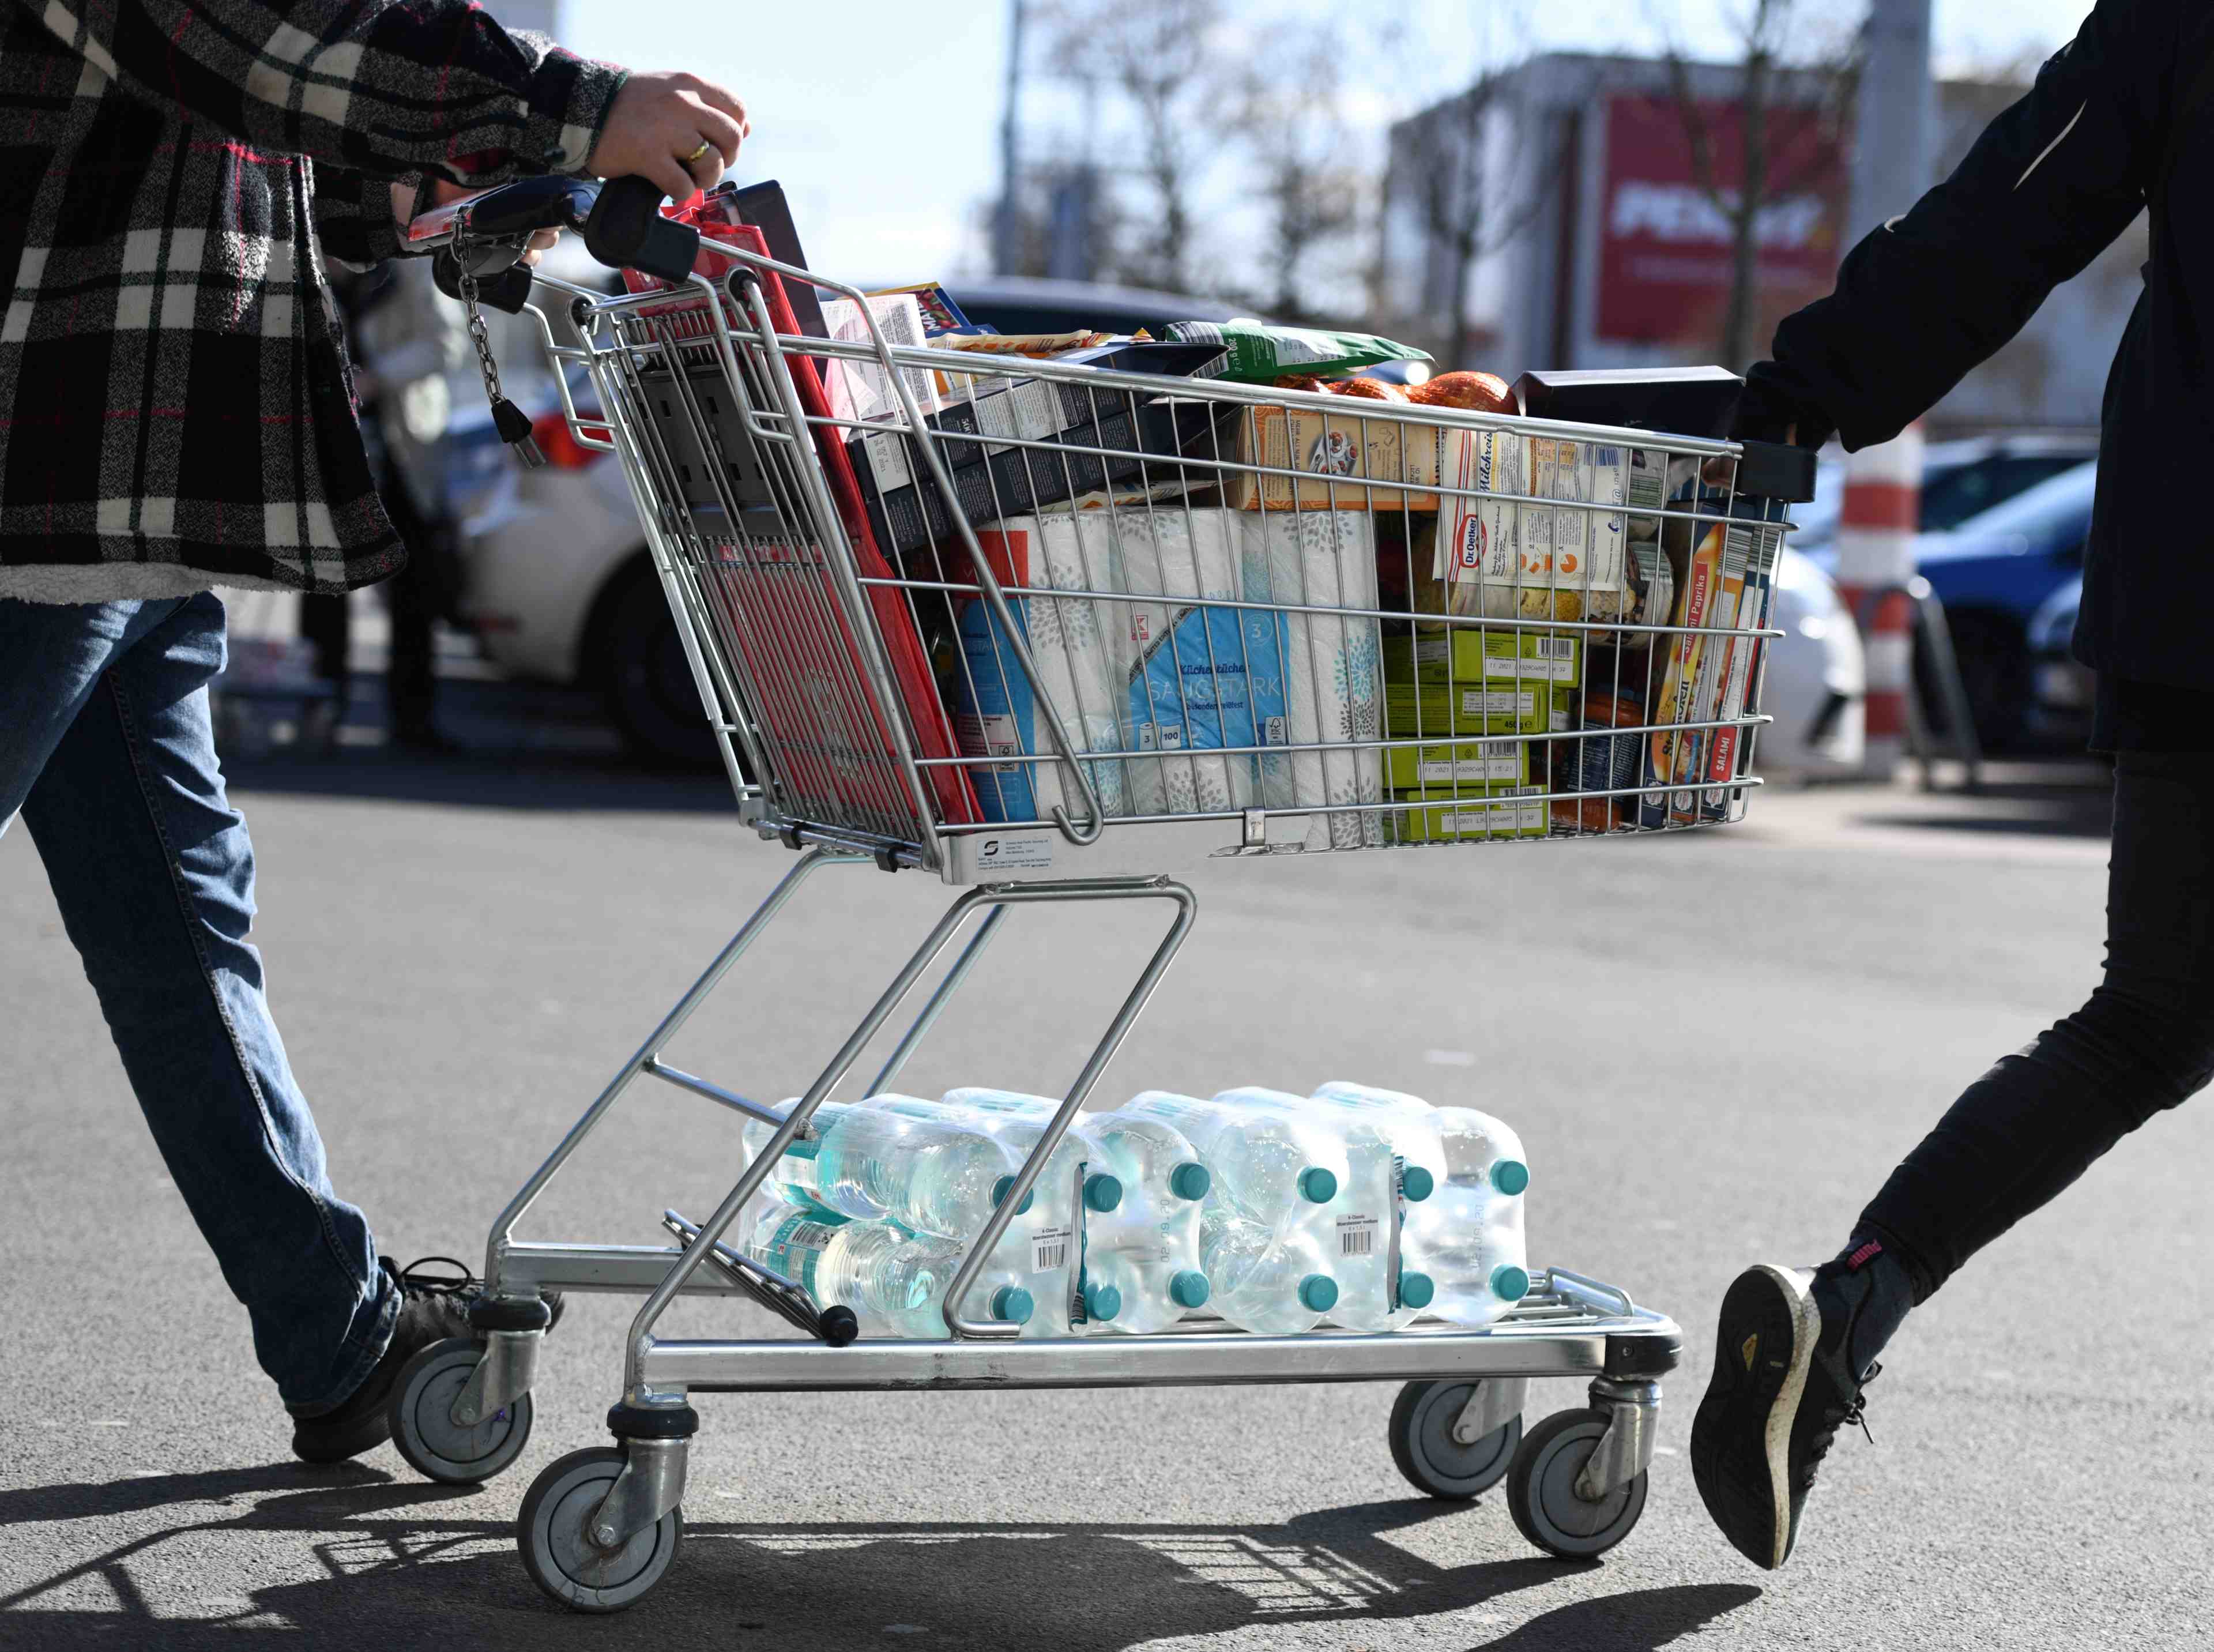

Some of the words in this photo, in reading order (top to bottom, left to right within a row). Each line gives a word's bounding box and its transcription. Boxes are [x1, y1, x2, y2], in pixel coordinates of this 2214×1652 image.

[1692, 574, 1706, 615] Paprika
[1251, 623, 1262, 638] 3
[1144, 735, 1150, 743] 3
[1716, 736, 1730, 772] SALAMI
